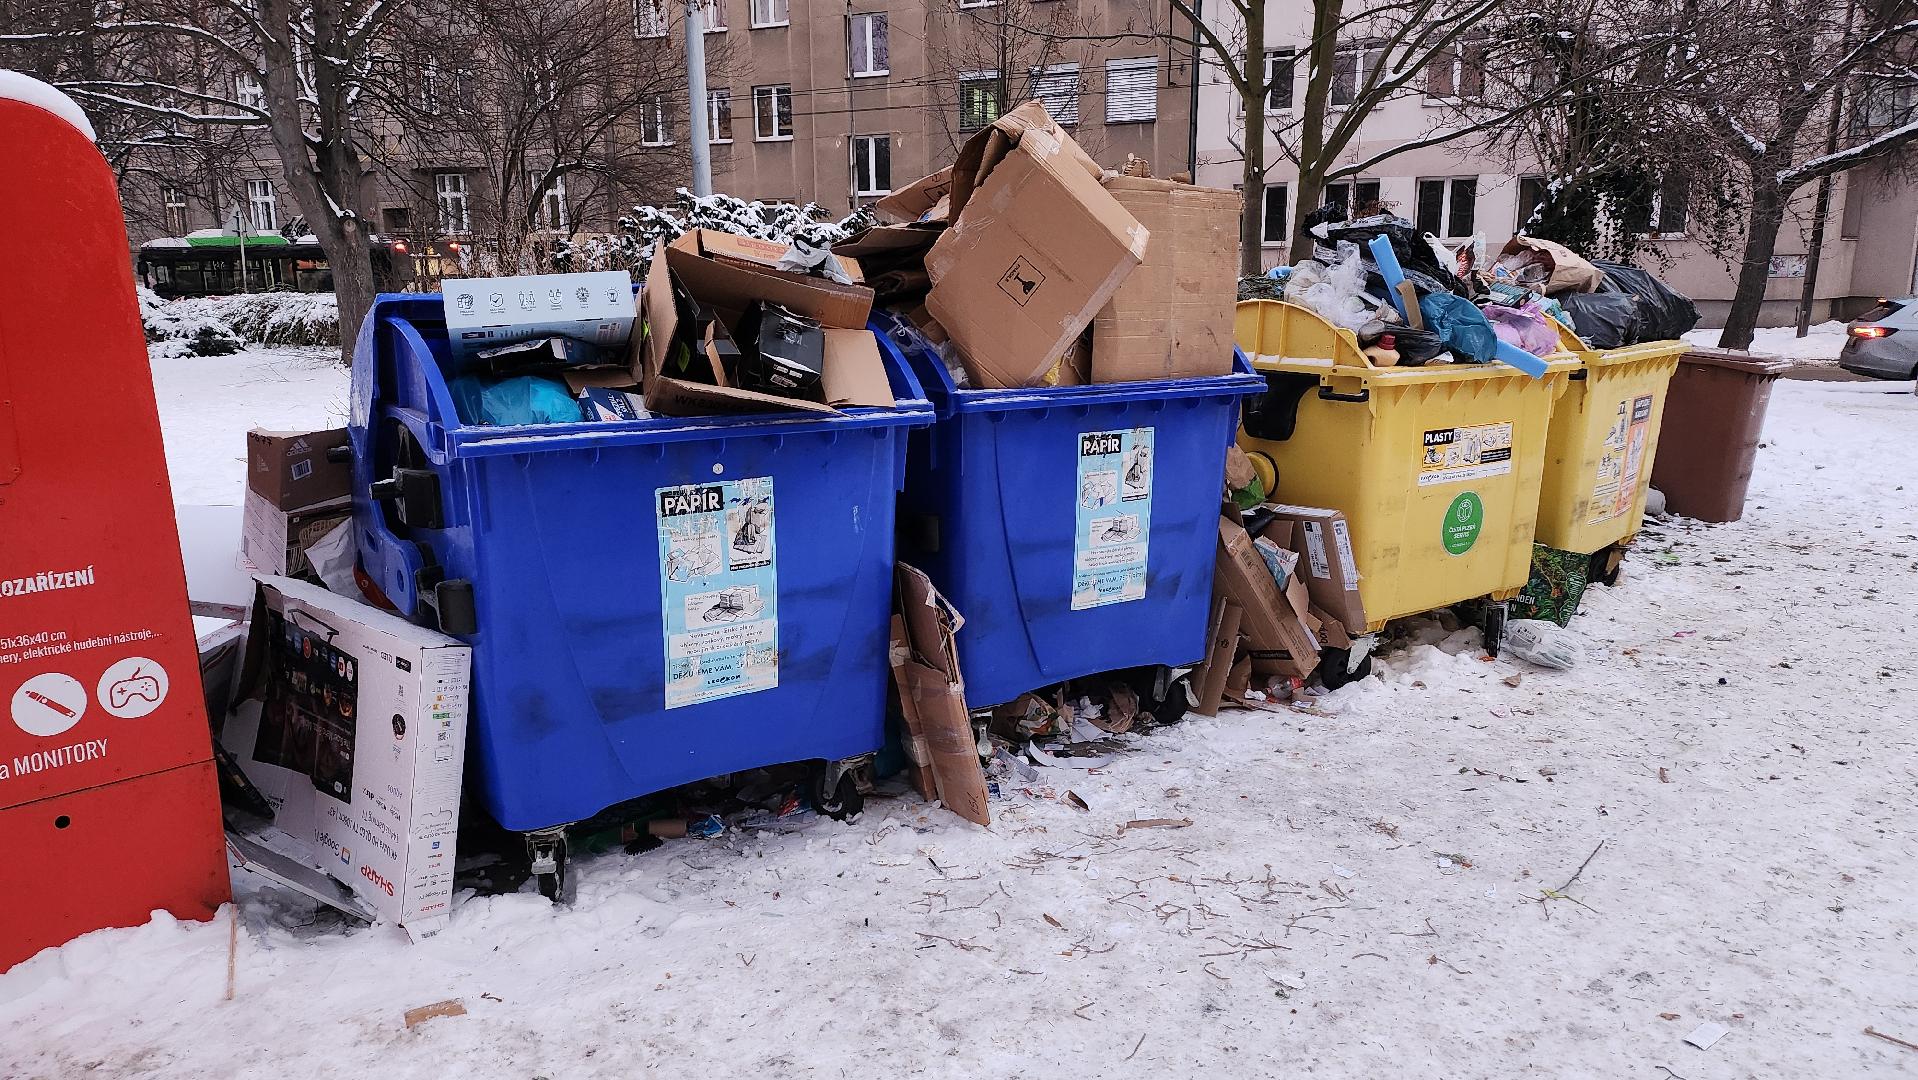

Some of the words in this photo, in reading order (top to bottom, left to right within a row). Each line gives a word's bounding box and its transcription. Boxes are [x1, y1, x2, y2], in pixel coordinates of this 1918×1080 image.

[1083, 434, 1120, 455] PAPÍR
[1425, 432, 1453, 444] PLASTY
[286, 446, 312, 457] adidas
[664, 489, 720, 515] PAPÍR
[0, 565, 95, 598] OZAŘÍZENÍ
[23, 641, 72, 661] elektrické
[73, 633, 112, 651] hudební
[50, 631, 67, 642] cm
[0, 764, 10, 779] a
[13, 738, 109, 777] MONITORY
[360, 864, 395, 897] SHARP
